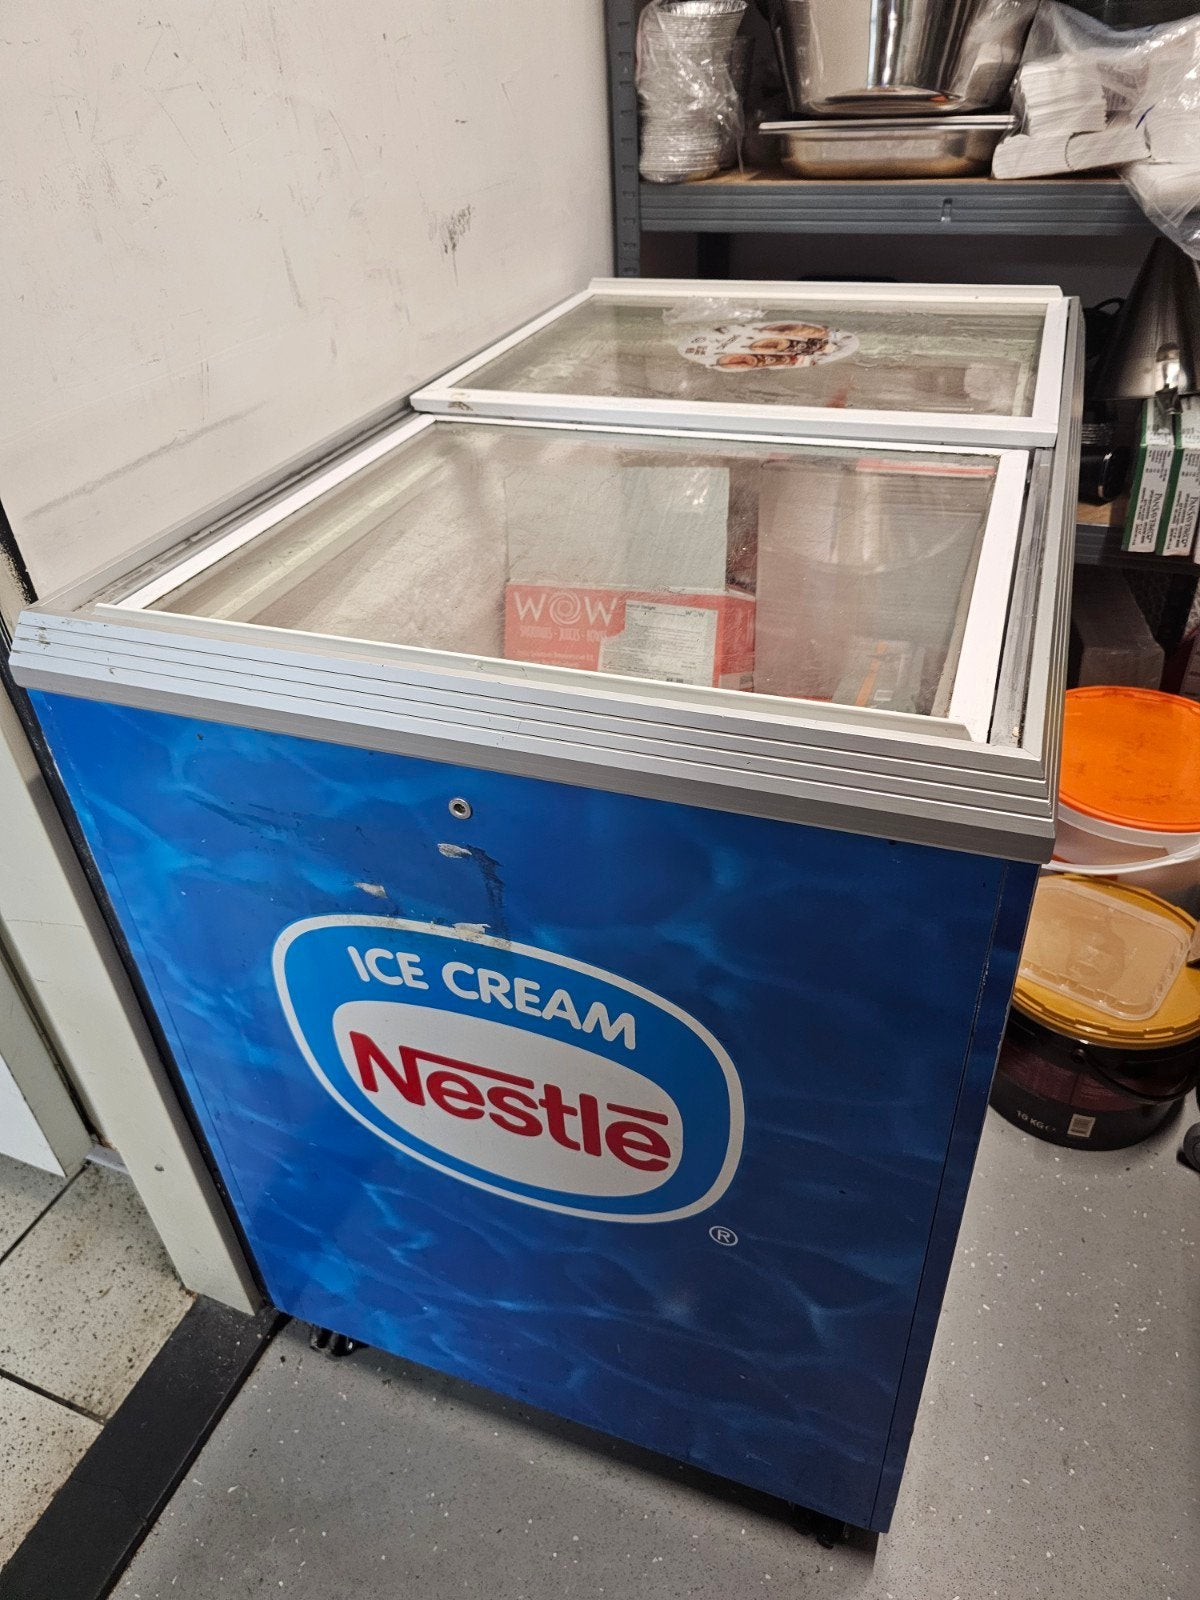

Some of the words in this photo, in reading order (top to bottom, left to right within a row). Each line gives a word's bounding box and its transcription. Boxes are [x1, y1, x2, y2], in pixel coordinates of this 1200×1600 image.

[513, 590, 618, 627] WOW
[348, 945, 430, 990] ICE
[442, 961, 637, 1051] CREAM
